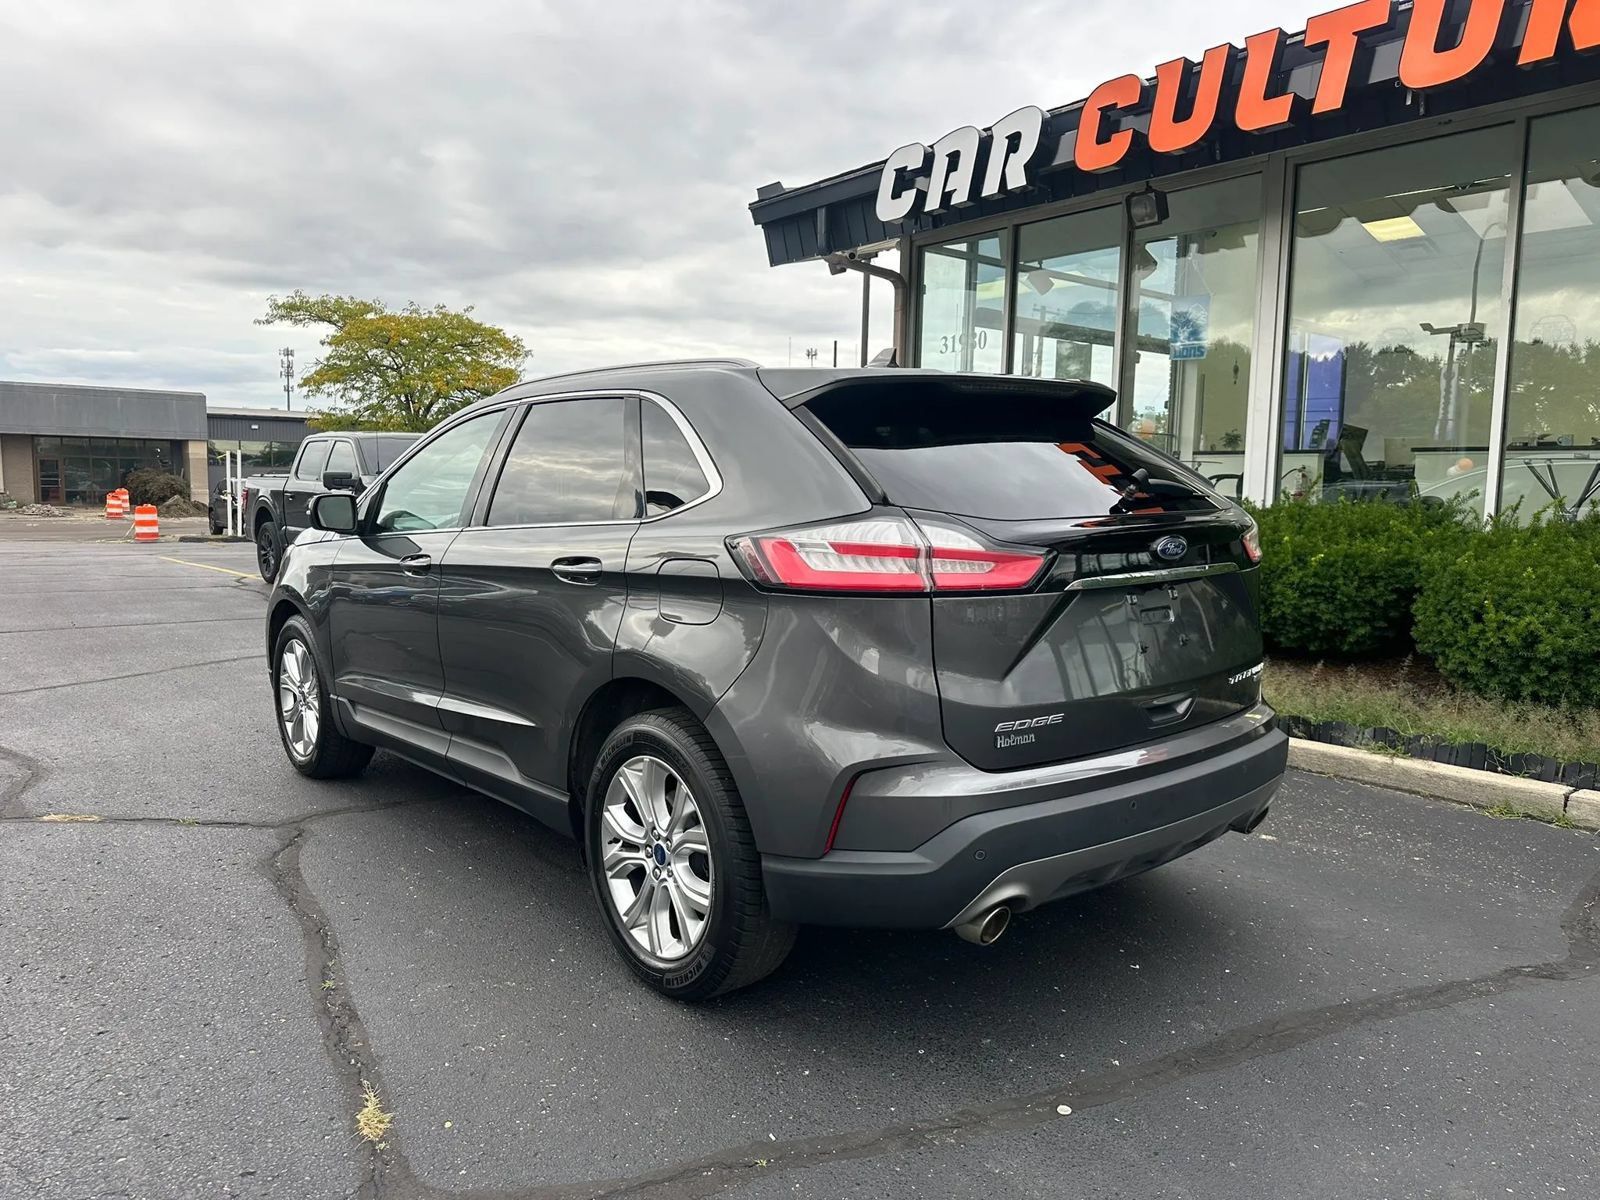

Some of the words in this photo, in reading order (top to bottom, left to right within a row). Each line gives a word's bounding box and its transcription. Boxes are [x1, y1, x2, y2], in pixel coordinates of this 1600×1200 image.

[875, 106, 1046, 223] CAR
[994, 713, 1065, 733] EDGE
[996, 733, 1036, 748] Holman
